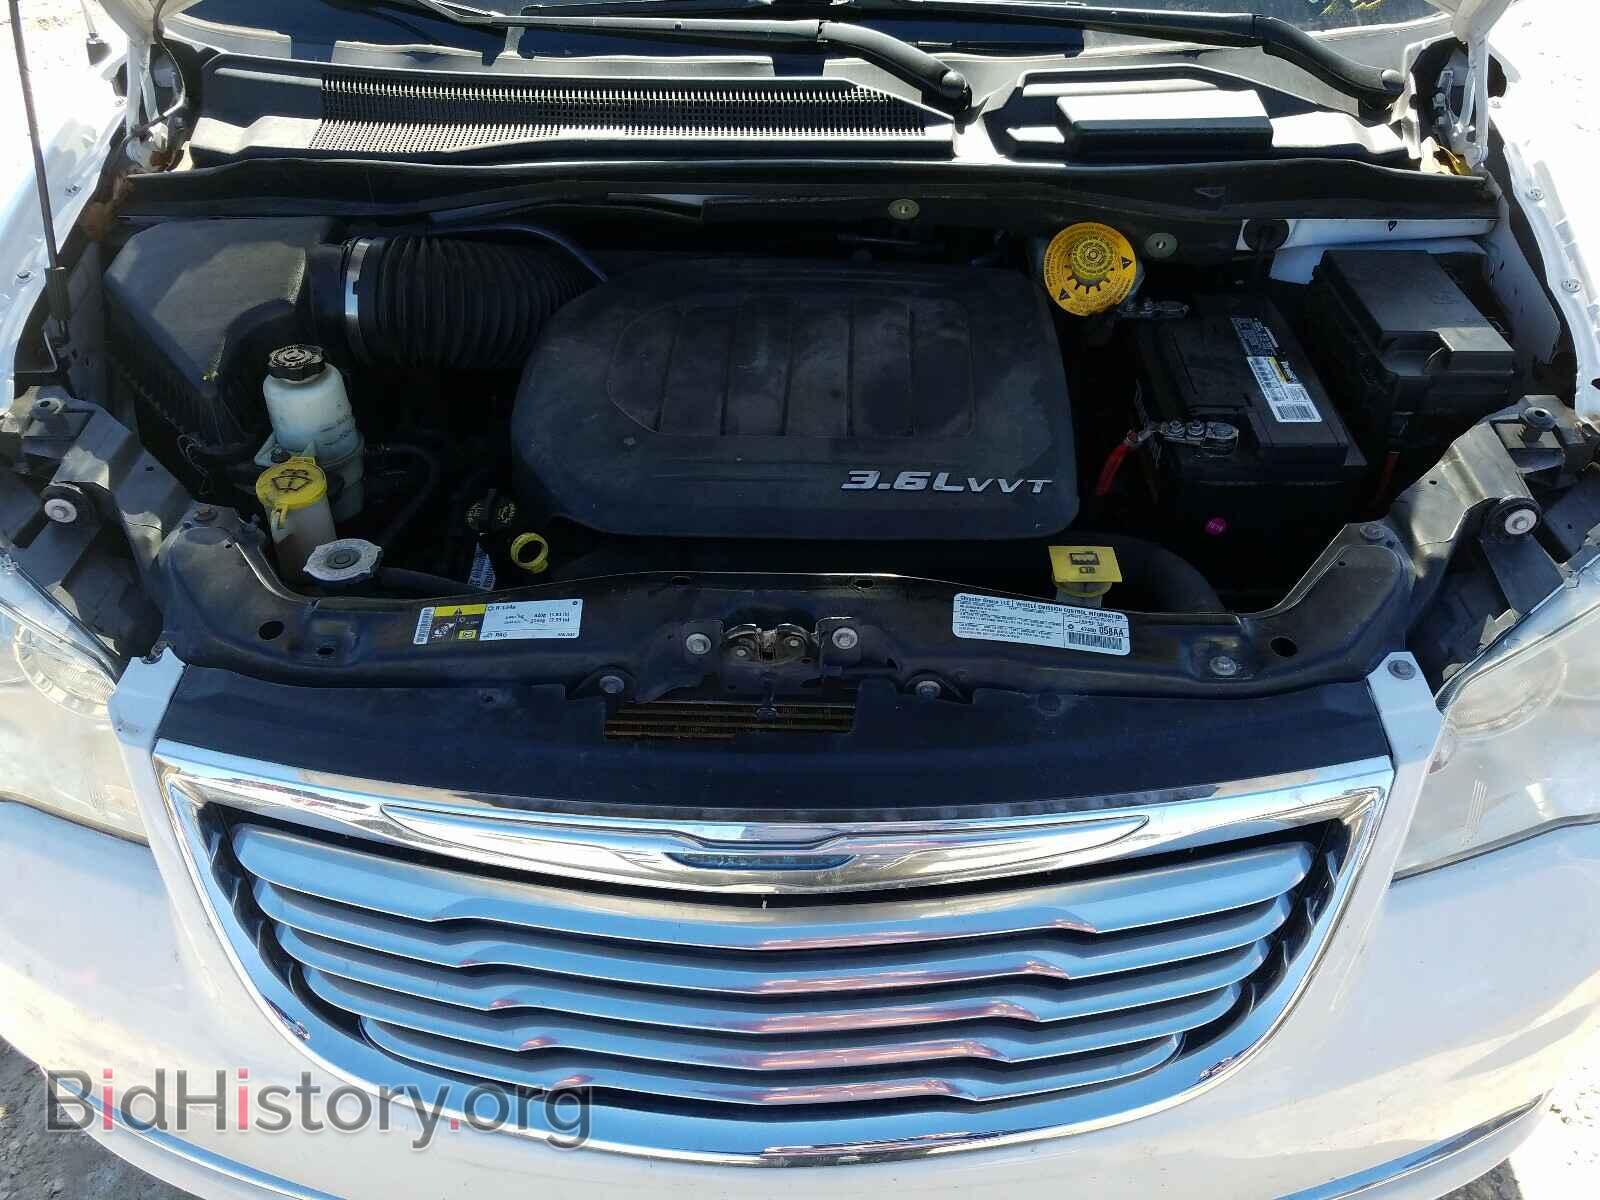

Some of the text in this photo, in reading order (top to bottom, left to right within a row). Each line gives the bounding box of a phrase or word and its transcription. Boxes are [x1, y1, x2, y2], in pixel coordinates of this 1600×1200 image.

[1016, 600, 1037, 609] VEHICLE
[1063, 607, 1087, 616] CONTROL
[1088, 611, 1123, 620] INFORMATION
